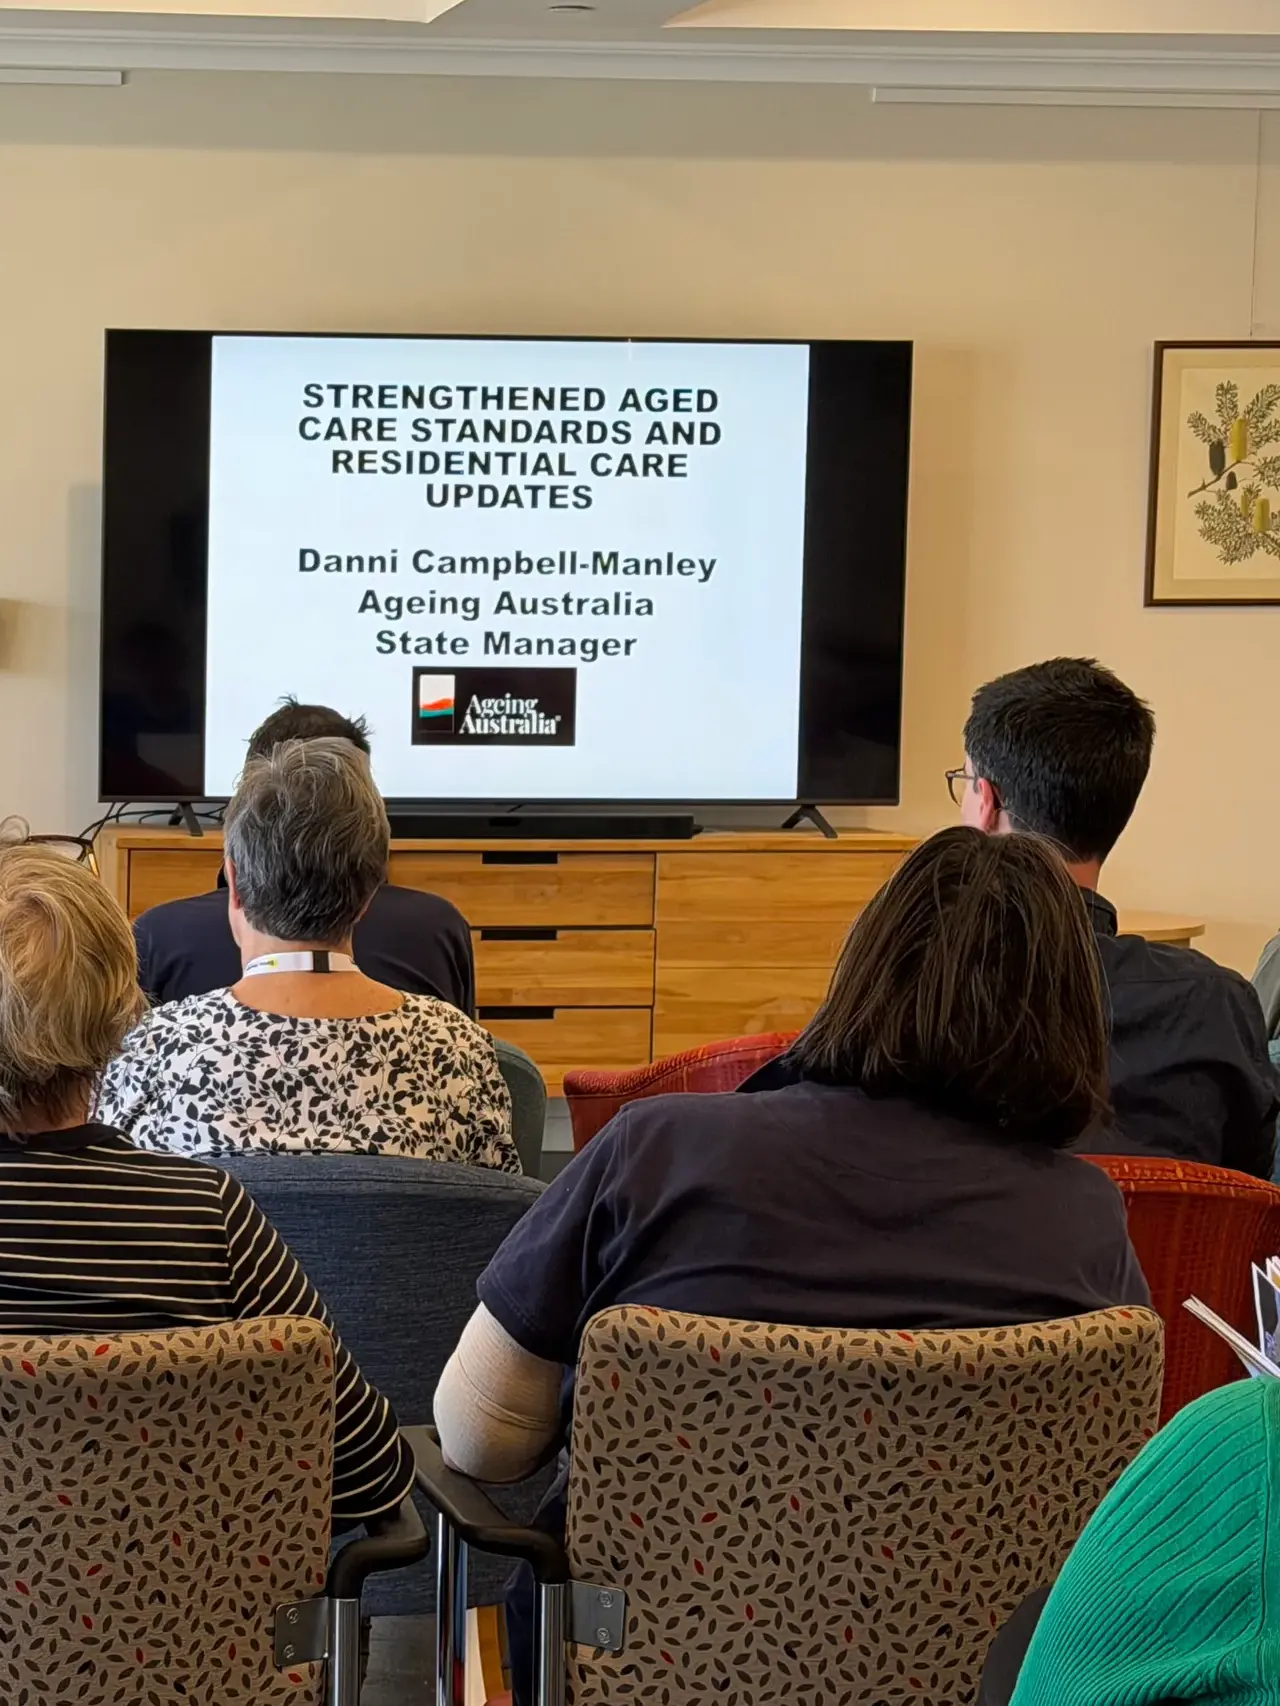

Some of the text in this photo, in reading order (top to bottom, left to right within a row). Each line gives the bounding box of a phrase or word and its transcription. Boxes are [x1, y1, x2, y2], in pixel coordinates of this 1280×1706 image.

[303, 383, 718, 413] STRENGTHENED AGED
[298, 416, 721, 446] CARE STANDARDS AND
[332, 449, 688, 478] RESIDENTIAL CARE
[426, 483, 593, 510] UPDATES
[299, 548, 717, 583] Danni Campbell-Manley
[357, 589, 653, 621] Ageing Australia
[376, 630, 637, 663] State Manager
[466, 693, 539, 718] Ageing
